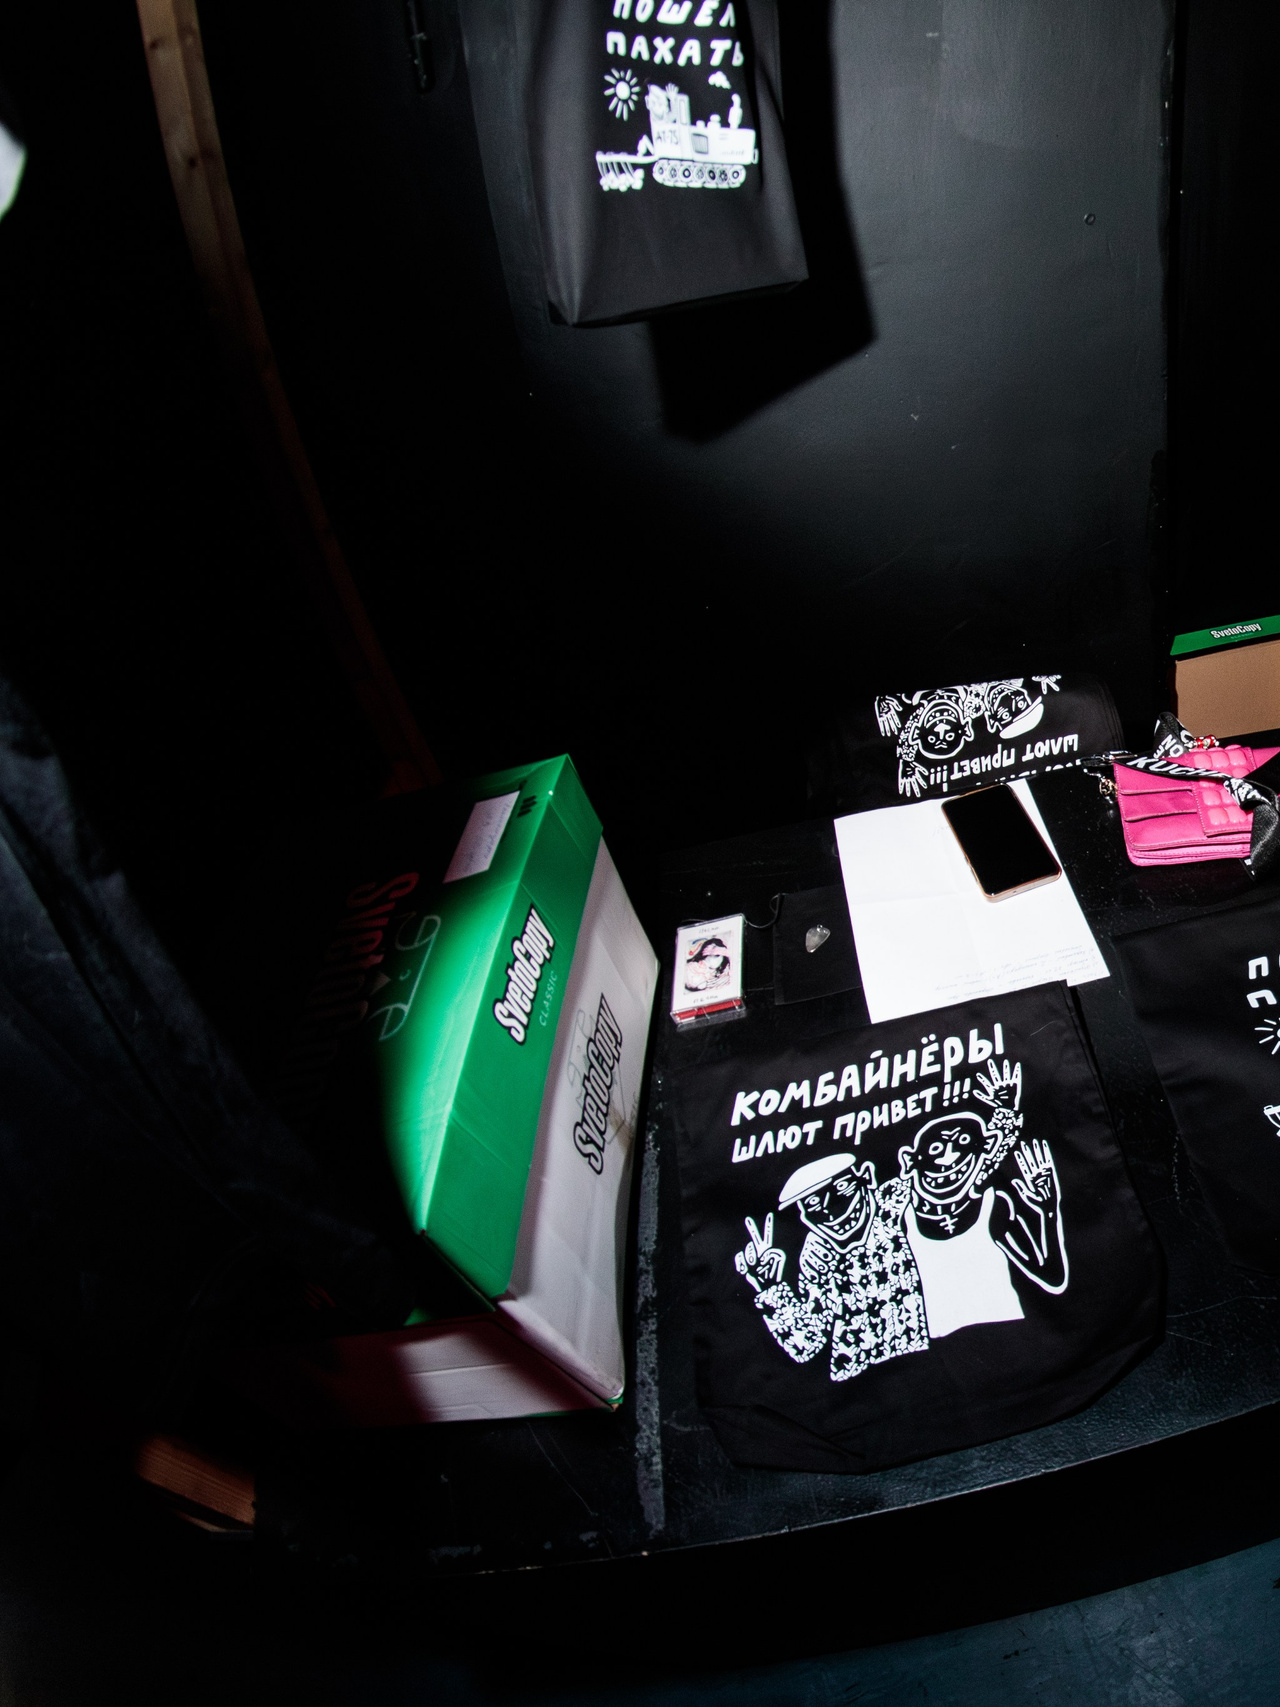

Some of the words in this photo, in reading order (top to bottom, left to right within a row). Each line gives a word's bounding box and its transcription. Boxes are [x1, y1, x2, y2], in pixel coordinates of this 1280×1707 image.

[606, 31, 744, 67] ПАХАТЬ
[1210, 622, 1262, 640] SvetoCopy
[1022, 734, 1078, 762] ШЛЮТ
[494, 903, 557, 1045] SvetoCopy
[539, 971, 559, 1027] CLASSIC
[573, 993, 624, 1175] SvetoCopy
[731, 1023, 1004, 1126] КОМБАЙНЁРЫ
[732, 1120, 823, 1163] ШЛЮТ
